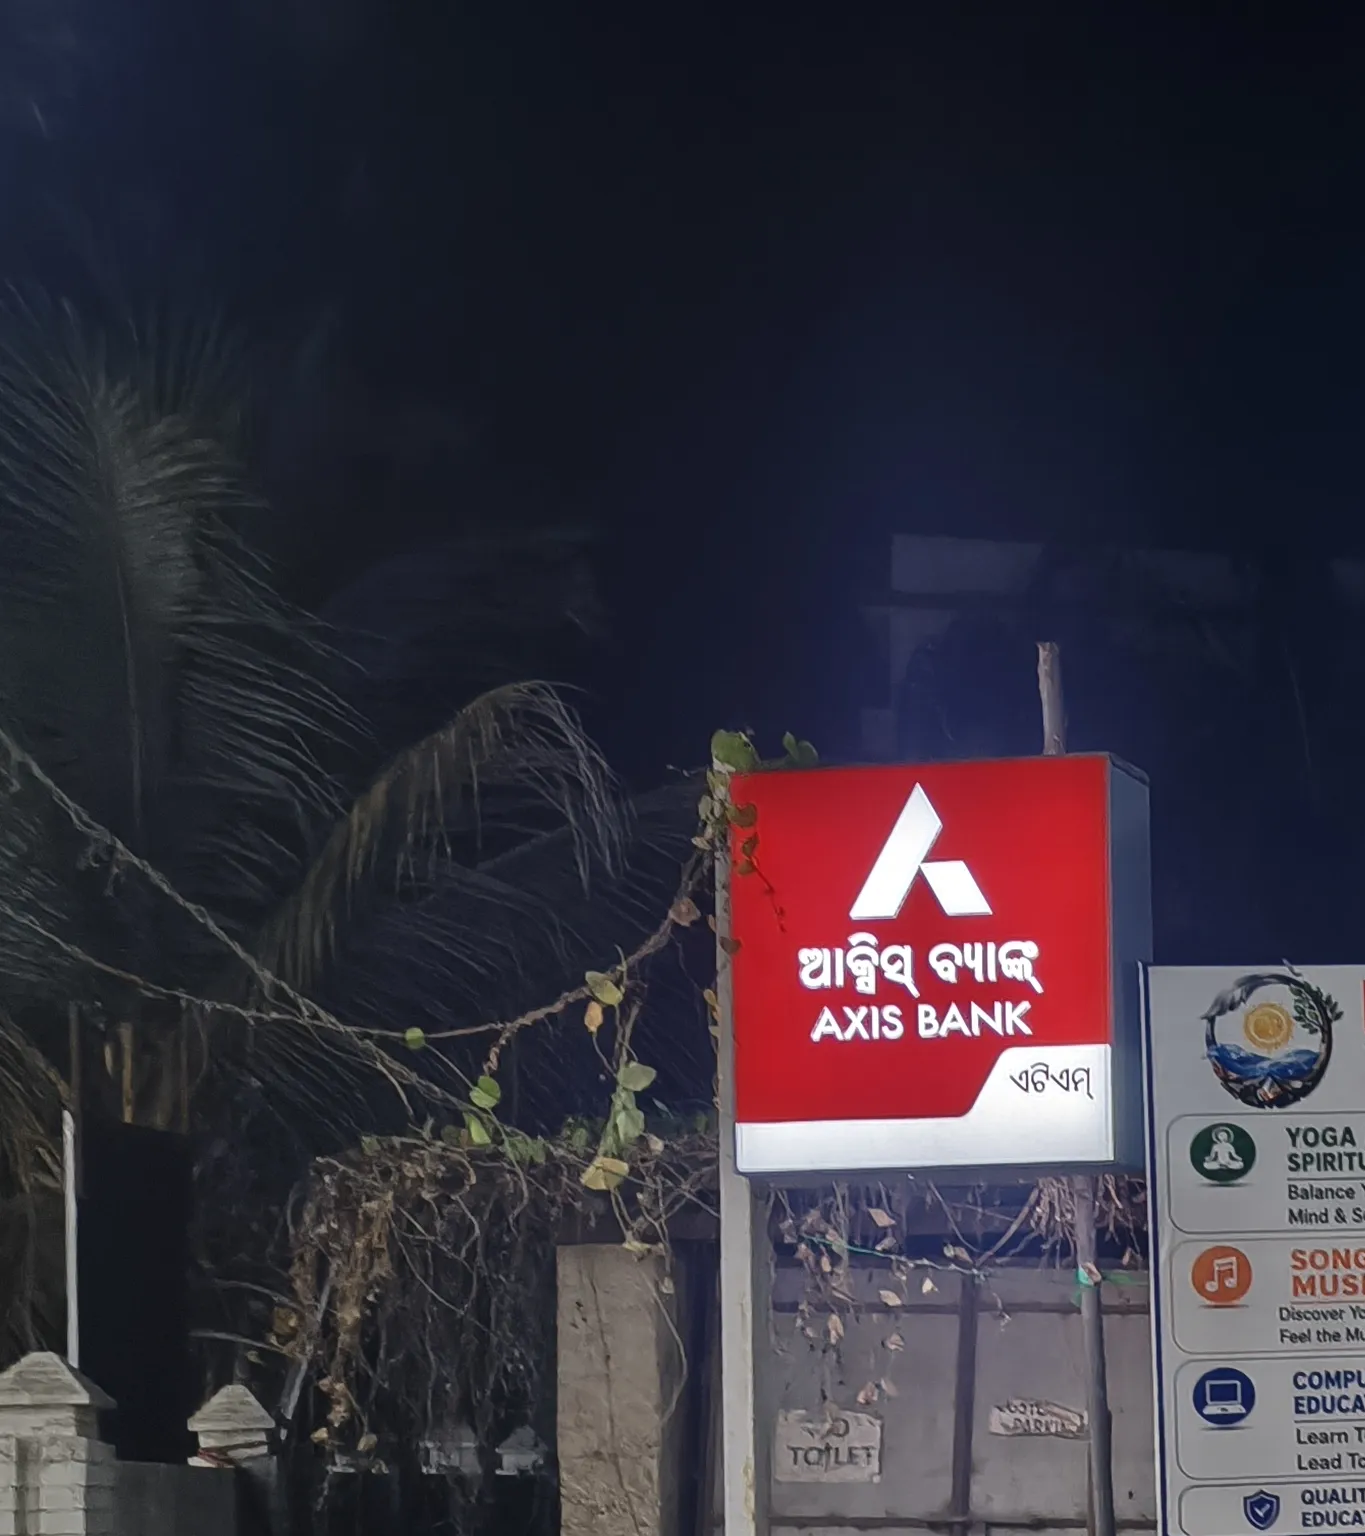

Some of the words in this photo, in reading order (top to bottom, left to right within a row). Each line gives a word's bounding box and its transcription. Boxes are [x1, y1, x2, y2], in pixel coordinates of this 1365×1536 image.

[809, 1004, 905, 1042] AXIS
[917, 1000, 1034, 1039] BANK
[1009, 1061, 1094, 1100] ଏଟିଏମ୍
[1286, 1126, 1357, 1148] YOGA
[1288, 1182, 1356, 1201] Balance
[1288, 1206, 1329, 1225] Mind
[1334, 1207, 1347, 1224] &
[1279, 1306, 1346, 1323] Discover
[1279, 1328, 1312, 1344] Feel
[1315, 1327, 1341, 1343] the
[1296, 1427, 1349, 1447] Learn
[1297, 1453, 1342, 1472] Lead
